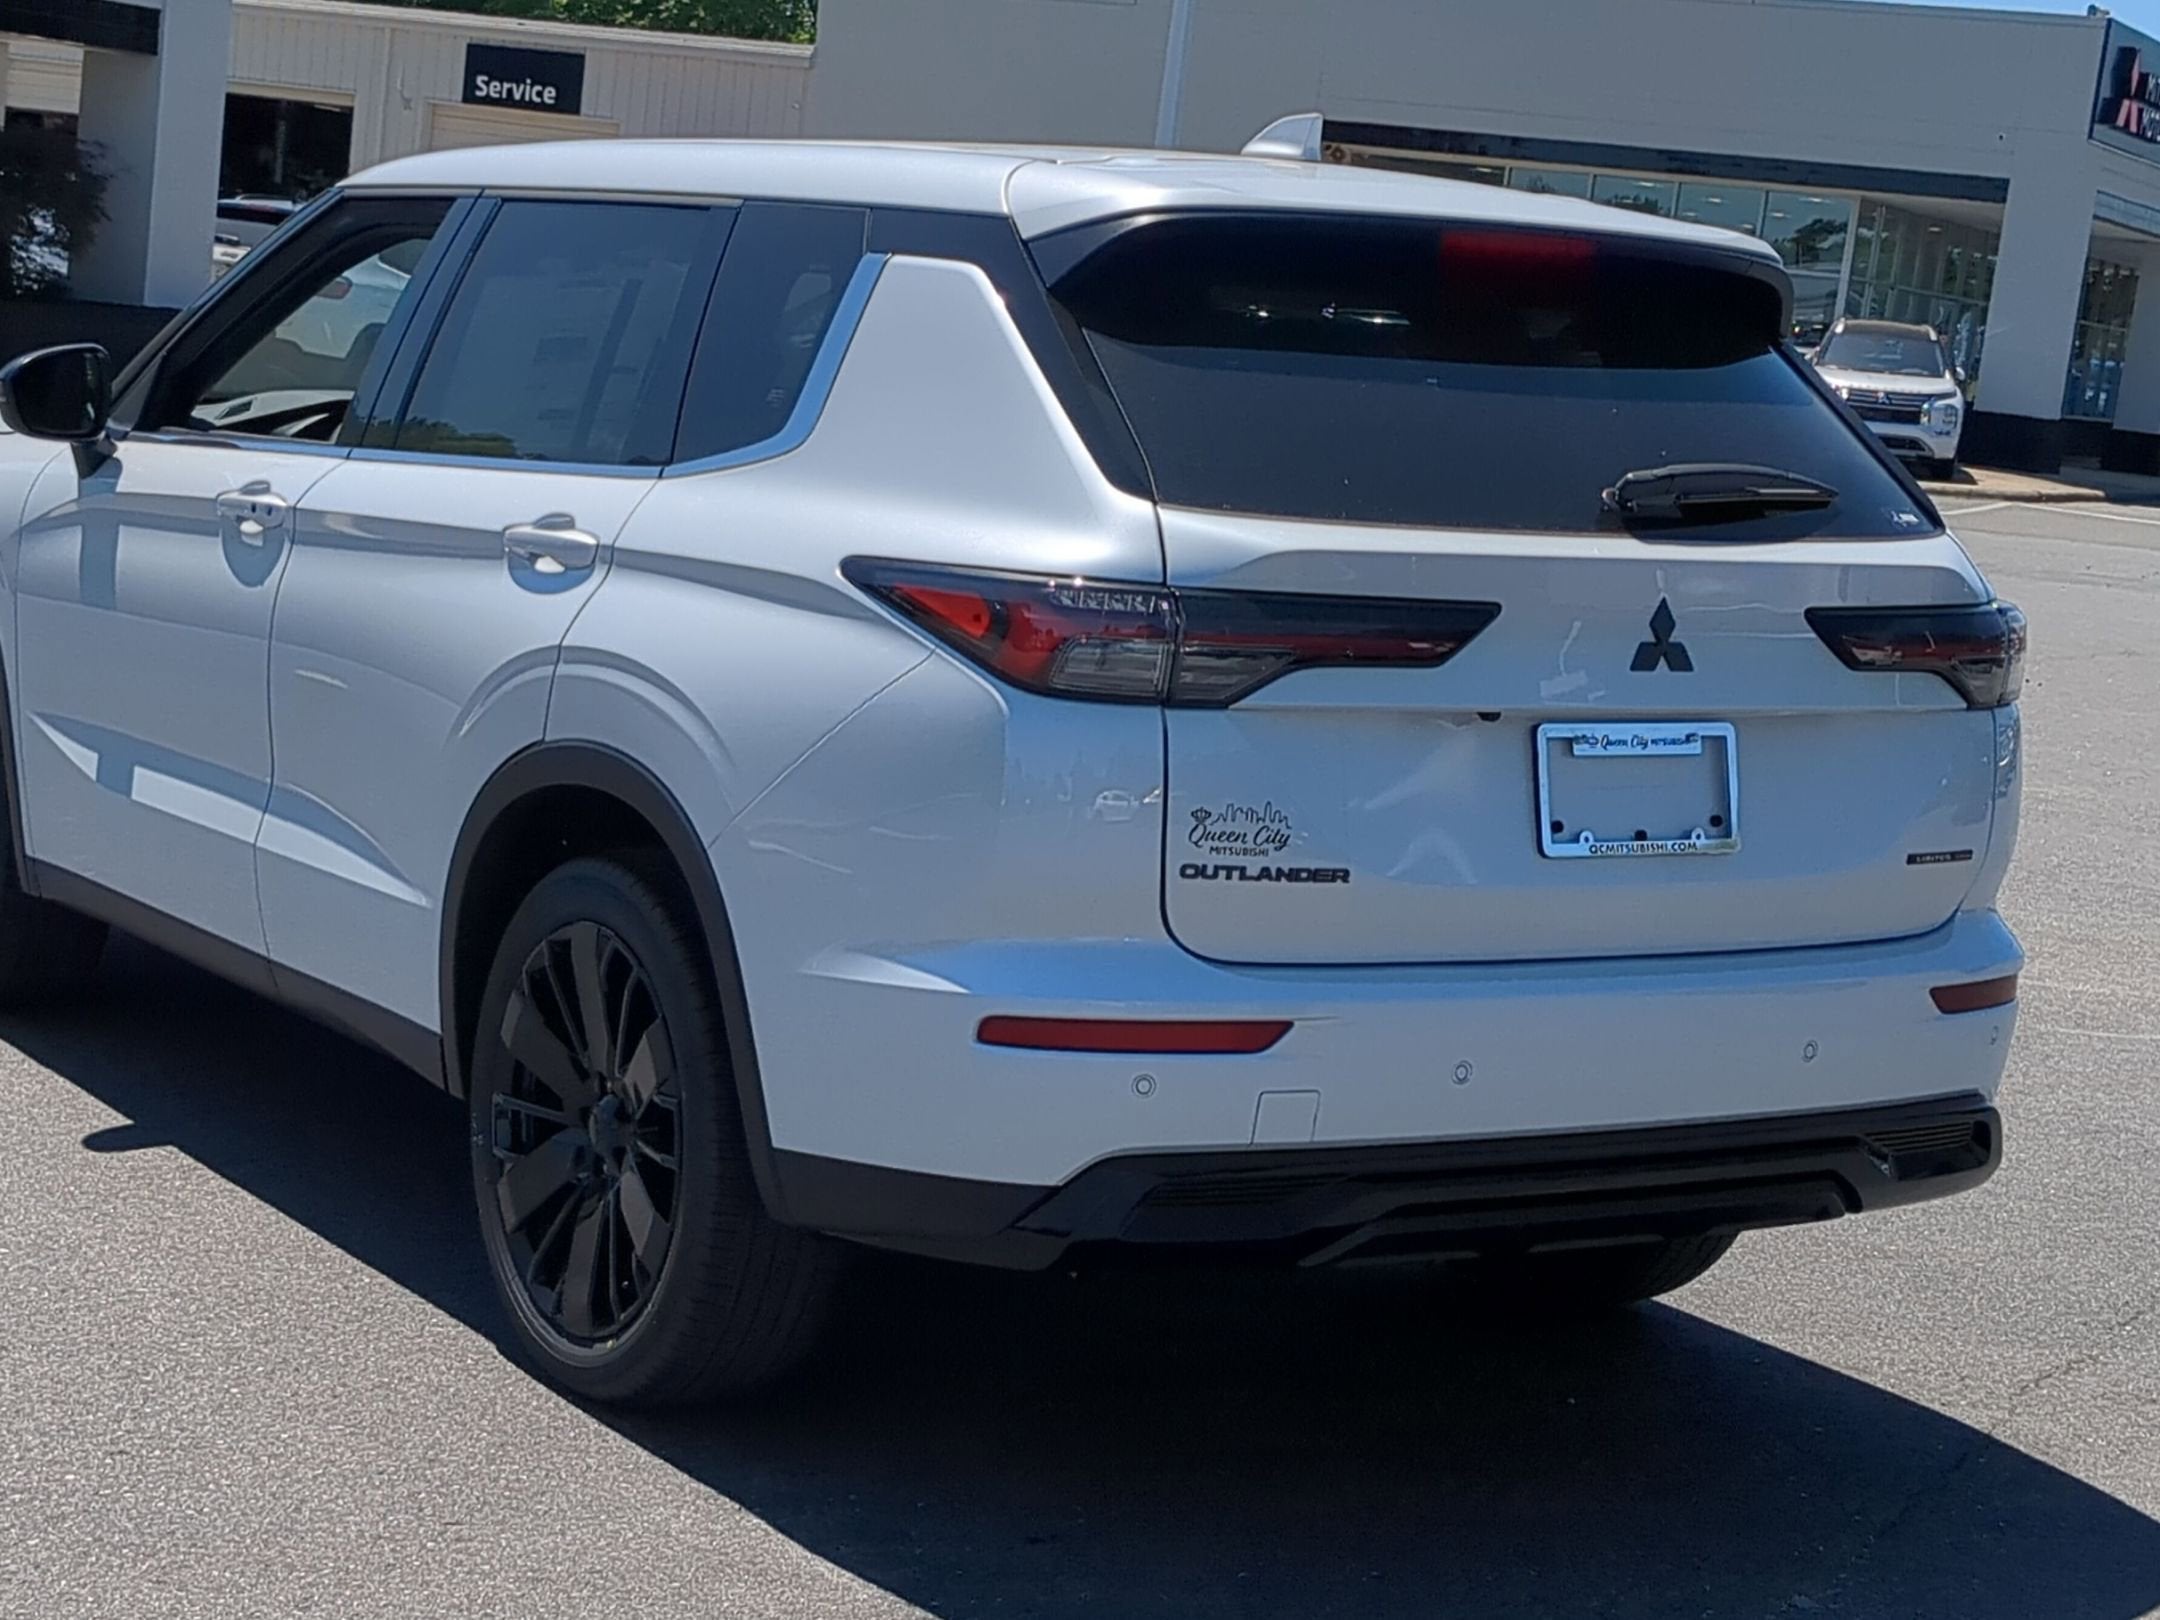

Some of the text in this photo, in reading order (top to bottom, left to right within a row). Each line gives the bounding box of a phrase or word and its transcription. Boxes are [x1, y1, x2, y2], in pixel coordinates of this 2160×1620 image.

[474, 75, 557, 104] Service
[1630, 734, 1649, 750] City
[1188, 823, 1291, 851] Queen City
[1209, 846, 1269, 857] MITSUBISHI
[1589, 841, 1698, 855] QCMITSUBISHI.COM
[1179, 863, 1351, 884] OUTLANDER
